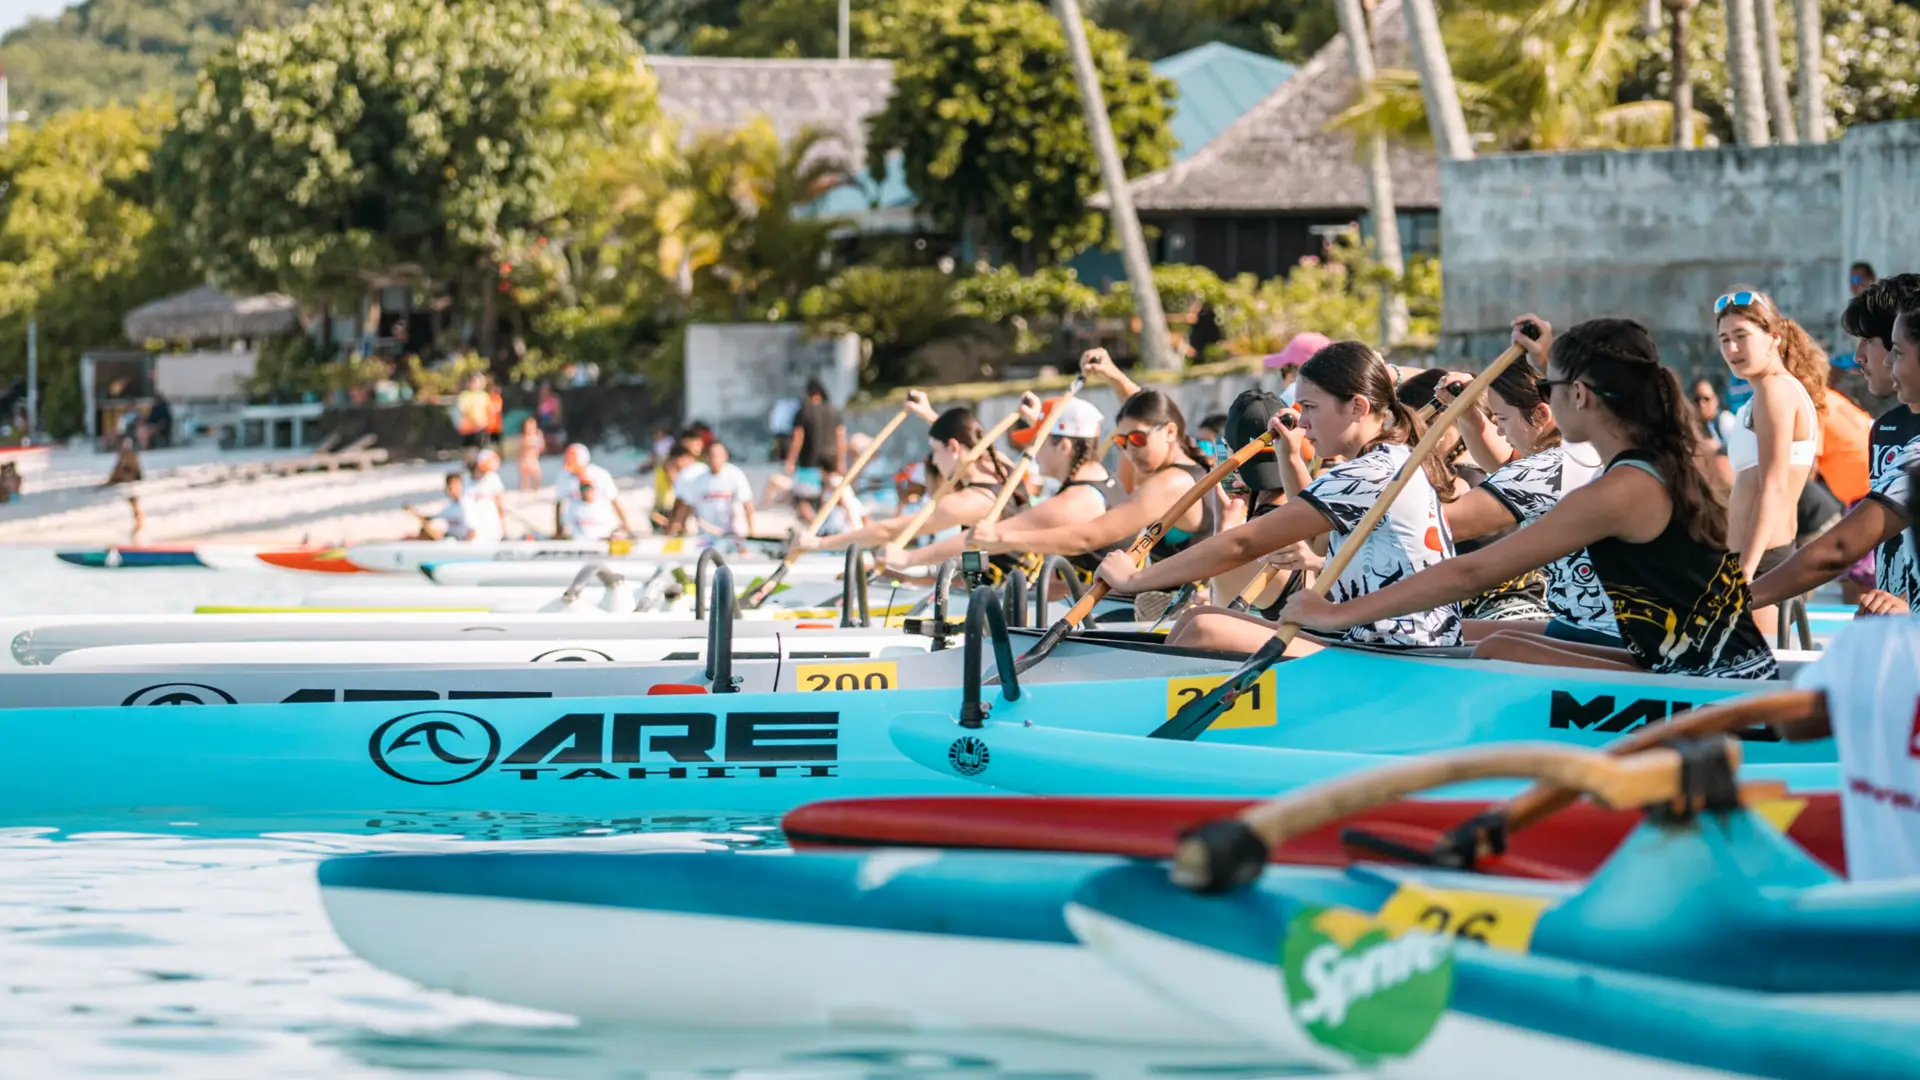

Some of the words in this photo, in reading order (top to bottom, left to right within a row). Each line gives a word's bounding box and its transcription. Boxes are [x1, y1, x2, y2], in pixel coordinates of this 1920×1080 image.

[806, 672, 889, 691] 200
[500, 711, 839, 764] ARE
[500, 765, 838, 780] TAHITI
